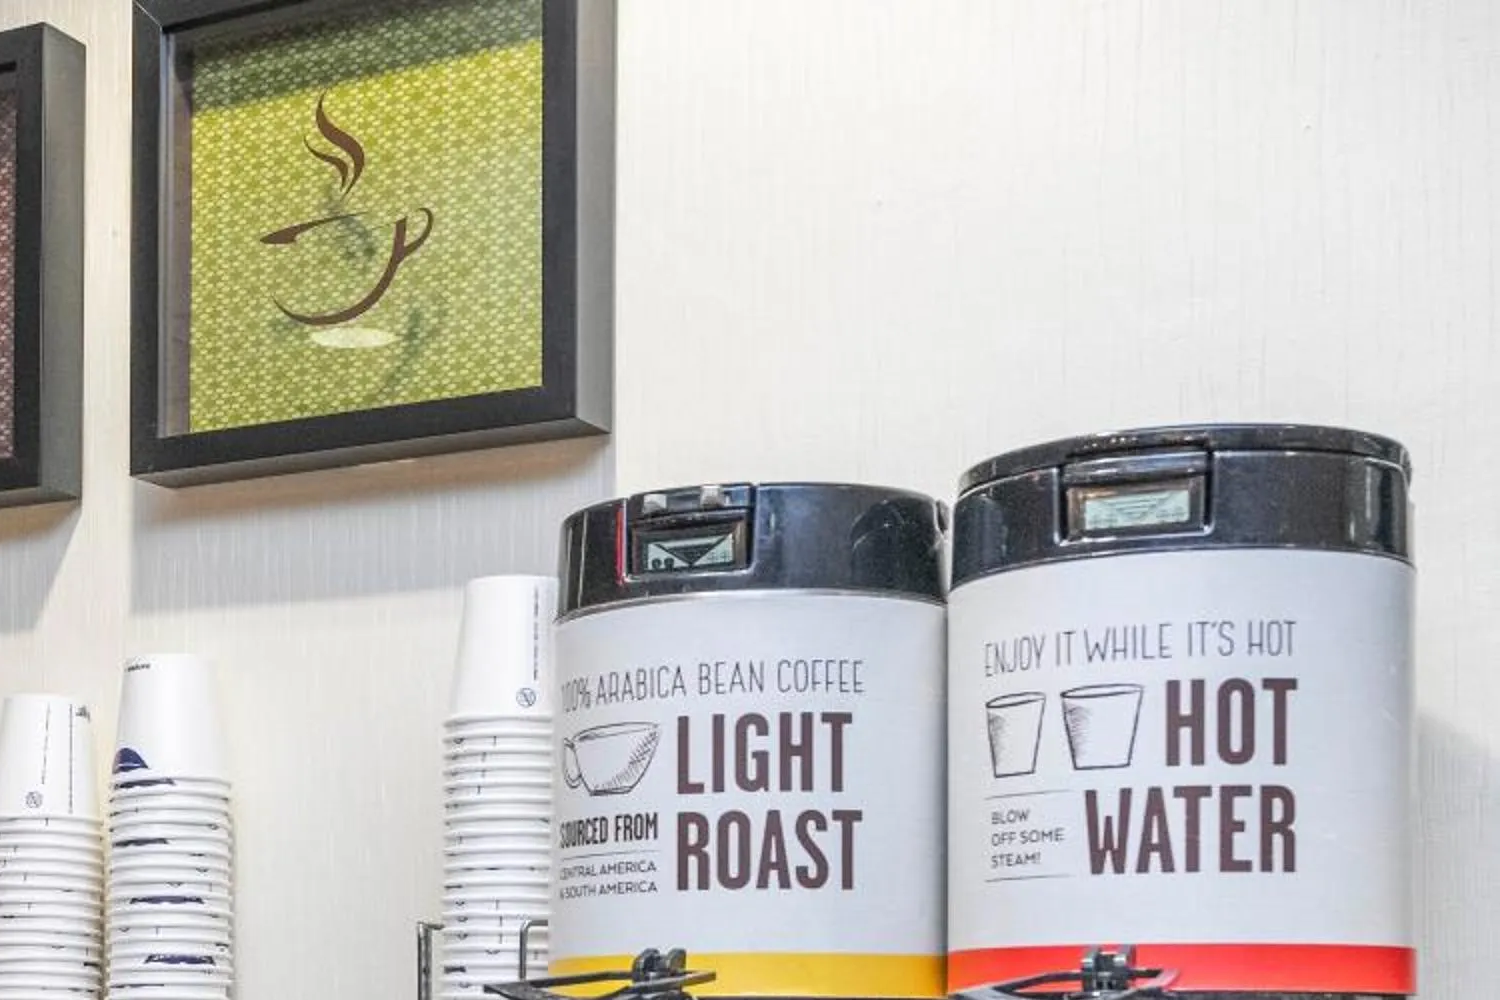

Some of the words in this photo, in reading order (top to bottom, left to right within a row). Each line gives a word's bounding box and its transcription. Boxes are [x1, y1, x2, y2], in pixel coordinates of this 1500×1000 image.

[985, 633, 1047, 677] ENJOY
[1055, 629, 1077, 668] IT
[1083, 622, 1173, 664] WHILE
[1187, 620, 1234, 658] IT'S
[1246, 619, 1297, 657] HOT
[596, 664, 687, 705] ARABICA
[698, 659, 766, 696] BEAN
[776, 659, 866, 694] COFFEE
[1165, 677, 1298, 767] HOT
[676, 711, 853, 795] LIGHT
[560, 816, 609, 849] SOURCED
[614, 812, 658, 843] FROM
[991, 809, 1031, 825] BLOW
[991, 831, 1017, 847] OFF
[1019, 826, 1066, 844] SOME
[1084, 784, 1298, 876] WATER
[599, 861, 658, 876] AMERICA
[676, 808, 864, 891] ROAST
[599, 880, 659, 895] AMERICA
